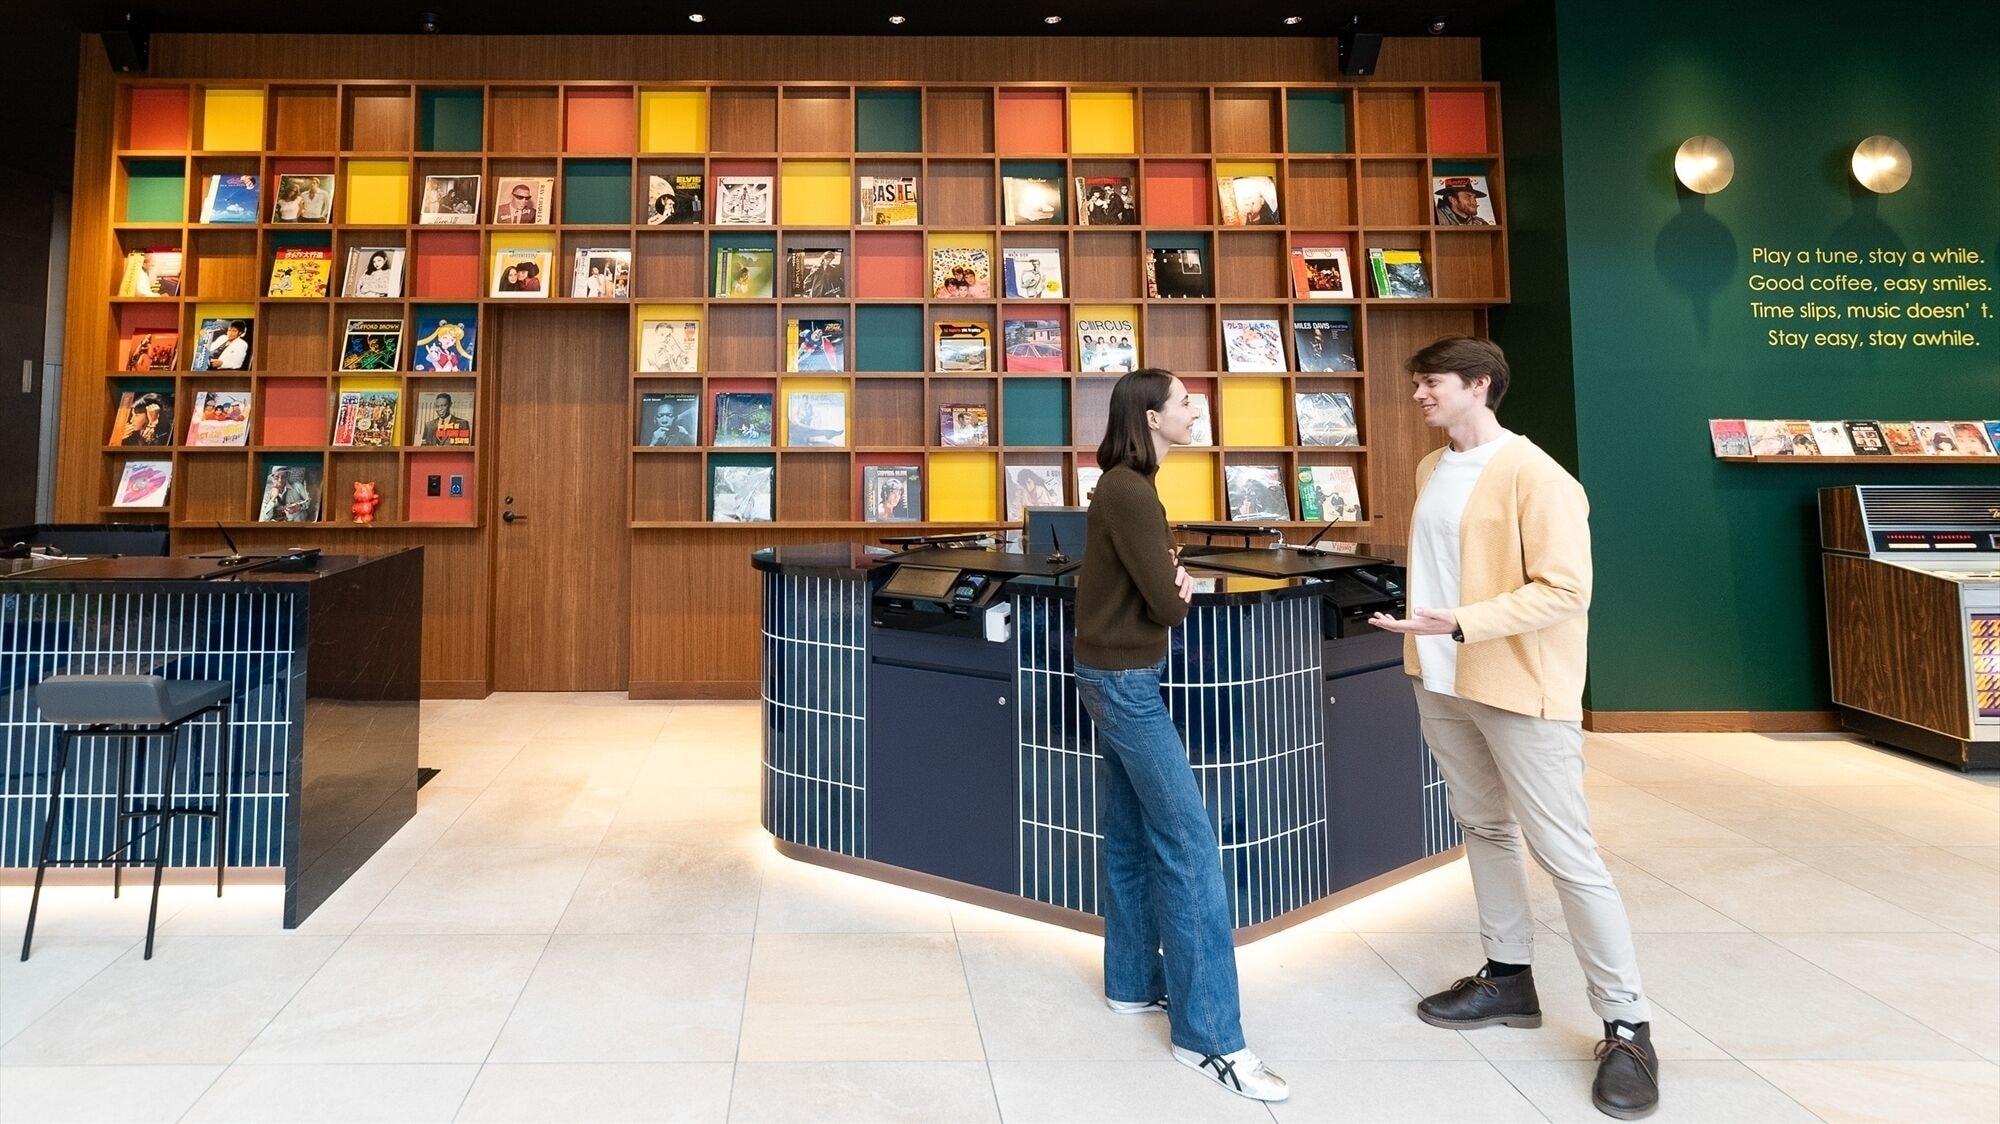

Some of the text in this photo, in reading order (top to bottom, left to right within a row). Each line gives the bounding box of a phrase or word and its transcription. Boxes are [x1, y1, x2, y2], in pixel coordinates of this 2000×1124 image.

[1752, 247, 1985, 267] Play a tune, stay a while.
[1749, 275, 1992, 294] Good coffee, easy smiles.
[1750, 302, 1794, 318] Time
[1800, 302, 1841, 322] slips,
[1847, 303, 1901, 318] music
[1294, 322, 1311, 330] MILES
[1312, 322, 1330, 330] DAVIS
[1768, 329, 1980, 349] Stay easy, stay awhile.
